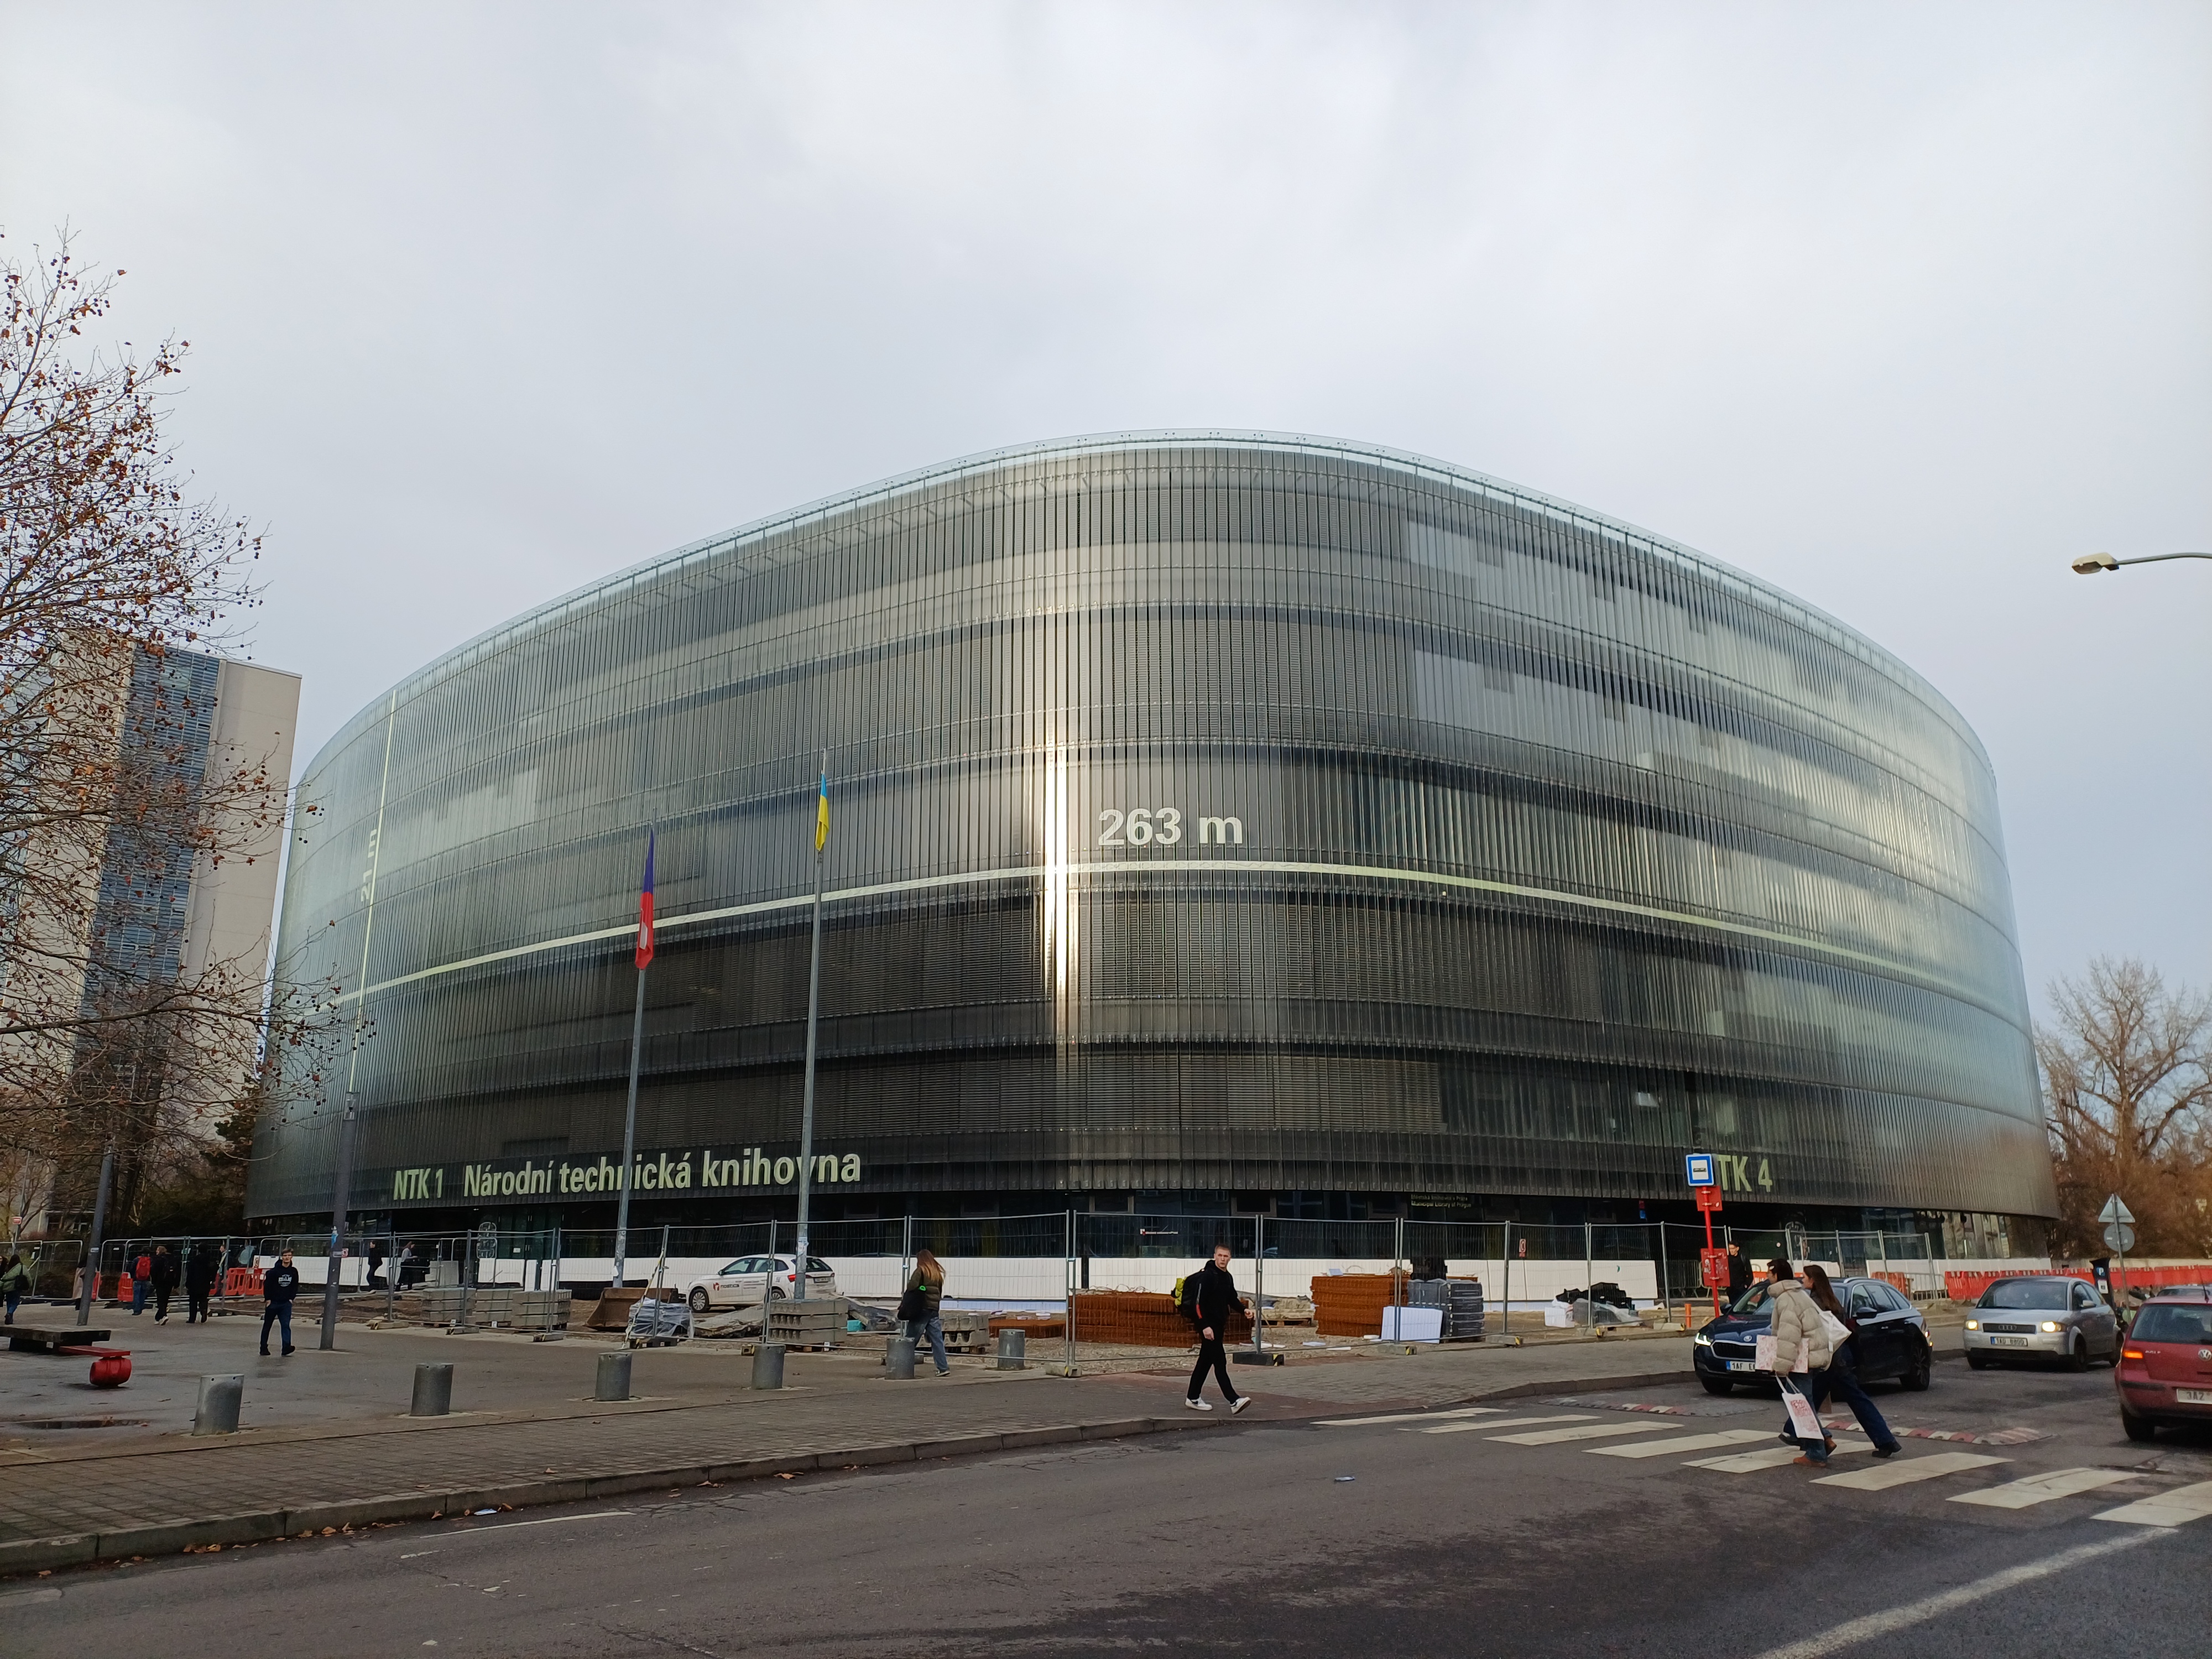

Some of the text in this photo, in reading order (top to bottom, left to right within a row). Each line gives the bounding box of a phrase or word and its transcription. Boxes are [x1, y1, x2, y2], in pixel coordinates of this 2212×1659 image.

[1097, 807, 1243, 846] 263 m
[360, 828, 377, 902] 21 m
[393, 1168, 444, 1201] NTK 1
[463, 1147, 861, 1197] Národní technická knihovna
[1713, 1154, 1773, 1192] TK 4
